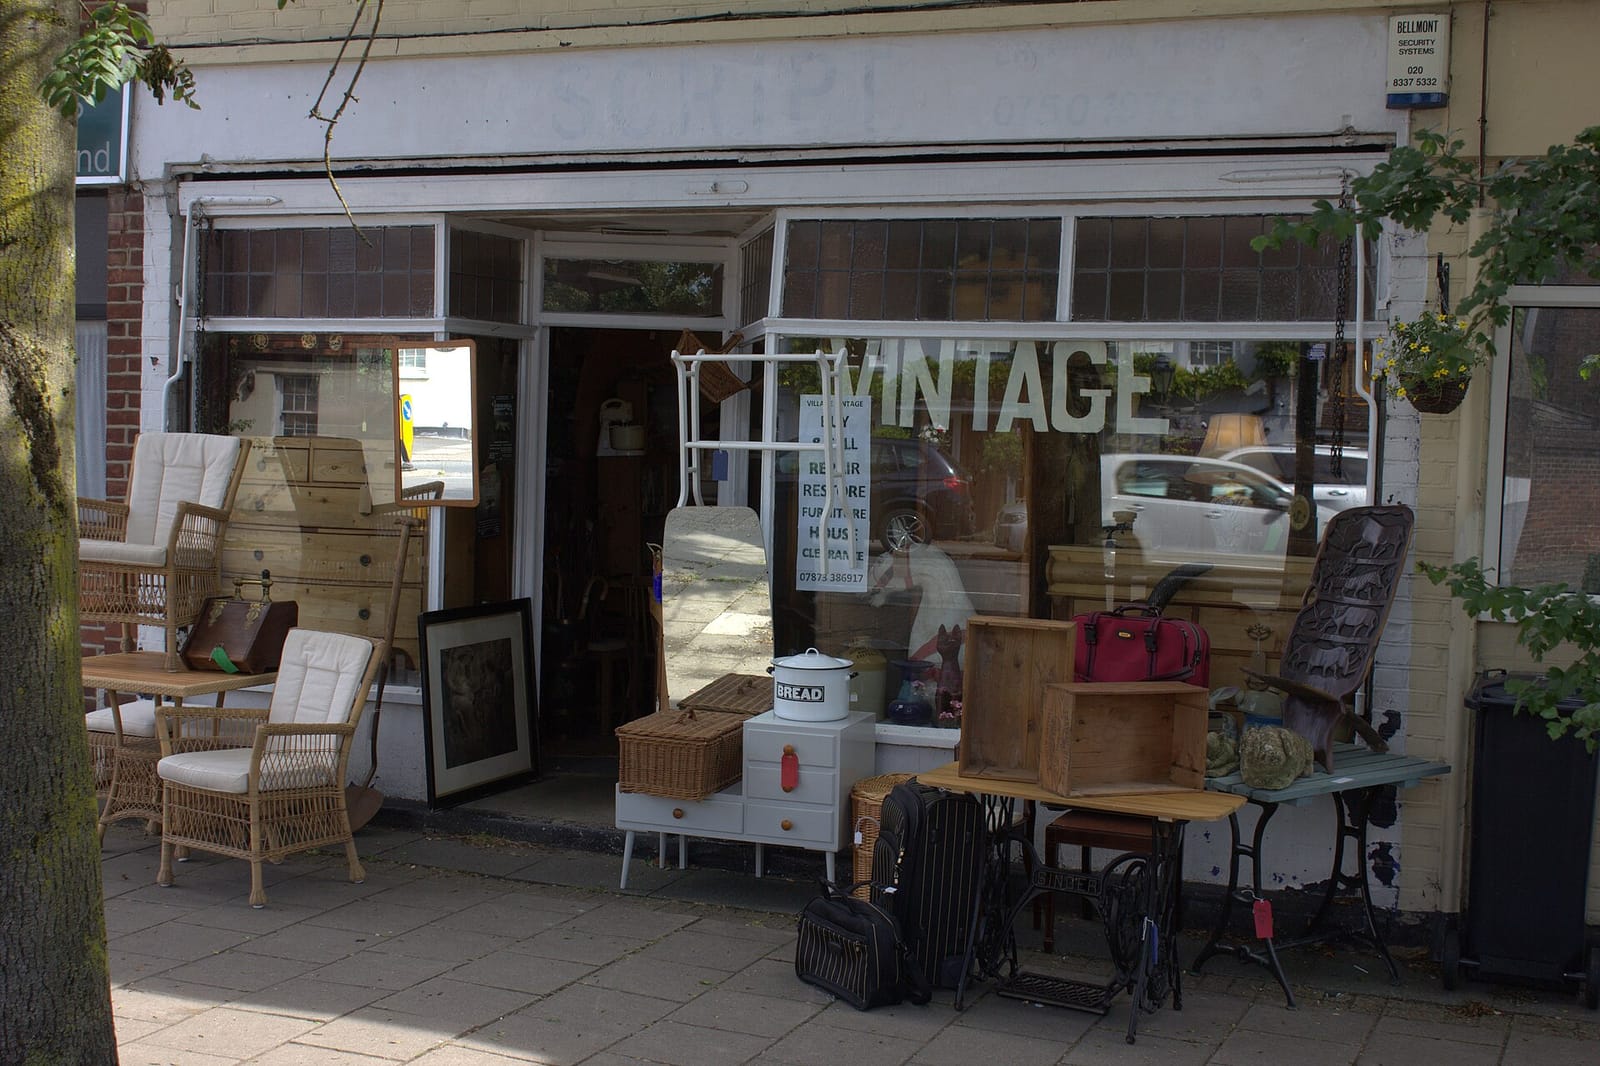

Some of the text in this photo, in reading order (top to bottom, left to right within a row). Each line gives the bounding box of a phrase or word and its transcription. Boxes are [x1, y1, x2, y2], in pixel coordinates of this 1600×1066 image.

[1397, 20, 1438, 33] BELLMONT
[1398, 39, 1435, 47] SECURITY
[1398, 47, 1434, 55] SYSTEMS
[1407, 66, 1424, 75] 020
[1393, 78, 1437, 87] 8337 5332
[830, 337, 1170, 435] VINTAGE
[830, 573, 864, 583] 386917
[777, 685, 822, 700] BREAD
[1038, 871, 1097, 895] SINGER
